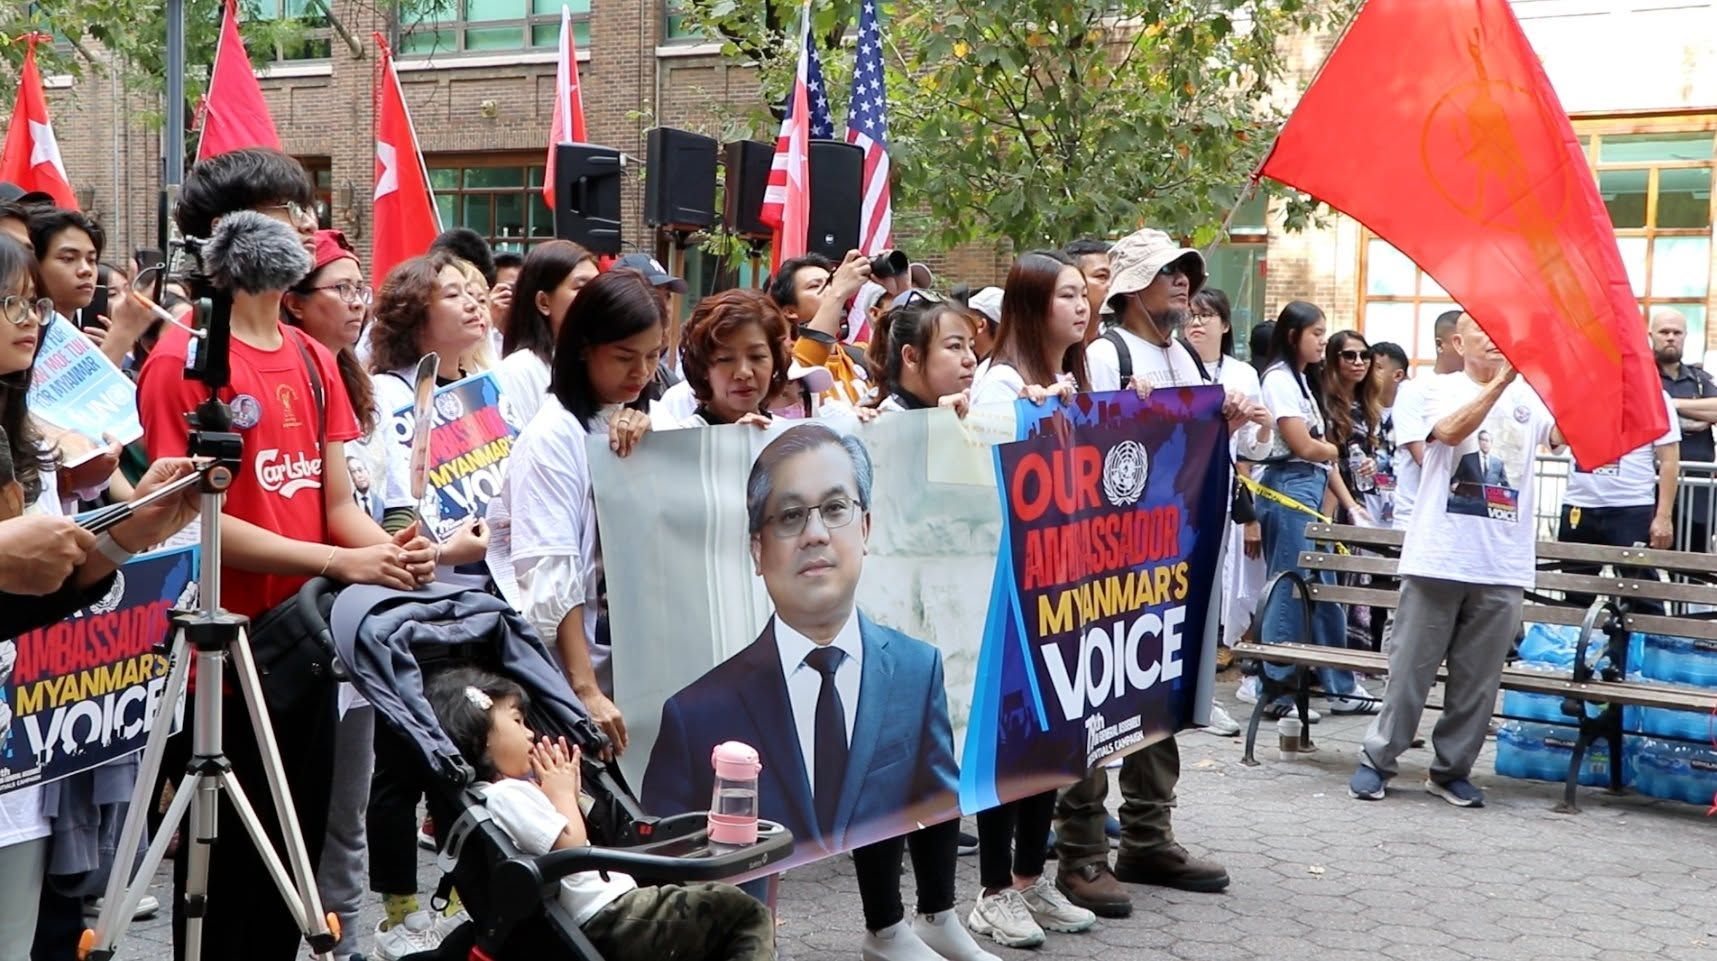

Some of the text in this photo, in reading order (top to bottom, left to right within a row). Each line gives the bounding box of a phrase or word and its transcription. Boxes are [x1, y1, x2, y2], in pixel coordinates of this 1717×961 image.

[50, 355, 101, 398] MYANMAR
[255, 448, 322, 492] Carlsbe
[1012, 444, 1102, 522] OUR
[1038, 562, 1189, 637] MYANMAR'S
[17, 653, 170, 717] MYANMAR'S
[1041, 605, 1186, 721] VOICE
